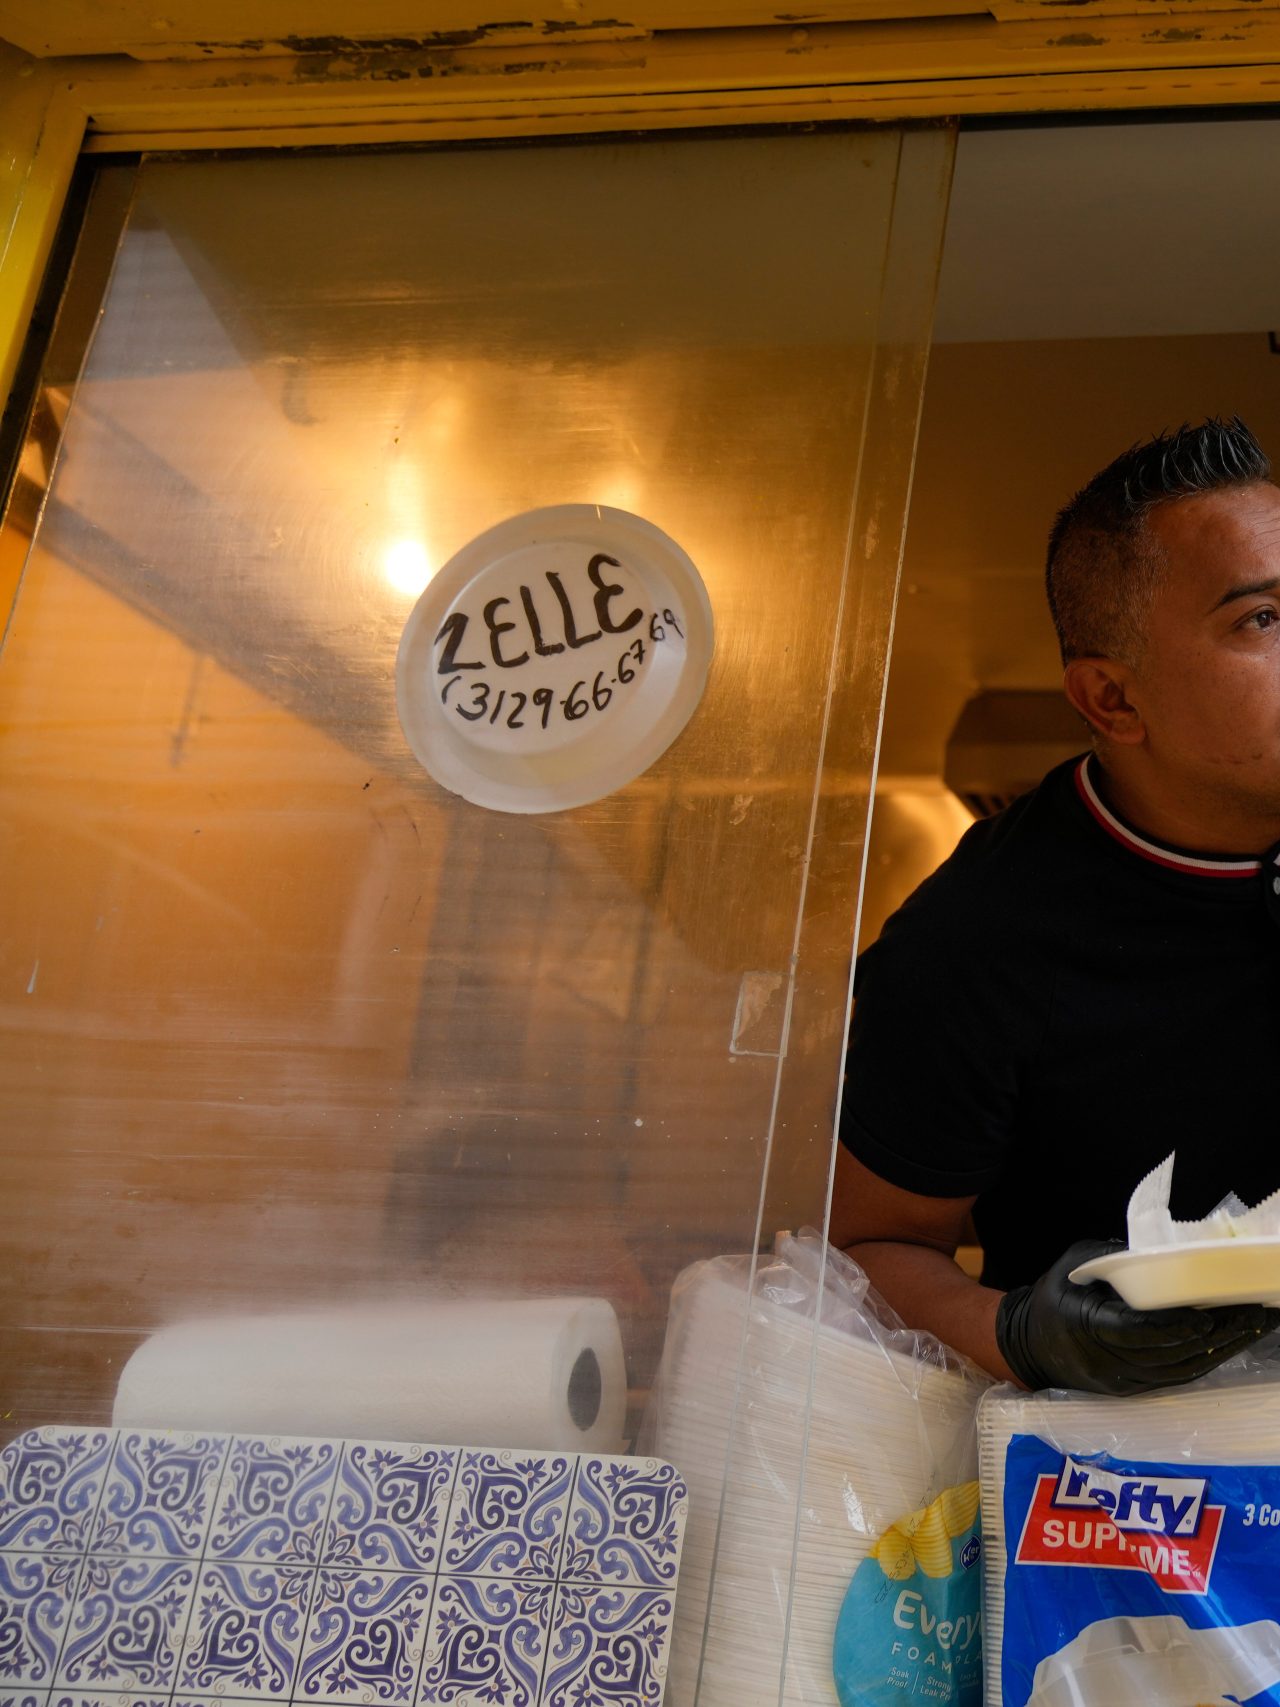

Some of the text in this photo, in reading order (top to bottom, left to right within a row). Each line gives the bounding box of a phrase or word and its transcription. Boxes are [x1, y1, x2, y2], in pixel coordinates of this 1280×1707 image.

[433, 553, 644, 675] ZELLE
[1242, 1503, 1256, 1527] 3
[893, 1589, 982, 1650] Every
[891, 1641, 952, 1674] FOAM
[891, 1666, 910, 1679] Soak
[920, 1687, 938, 1698] Leak
